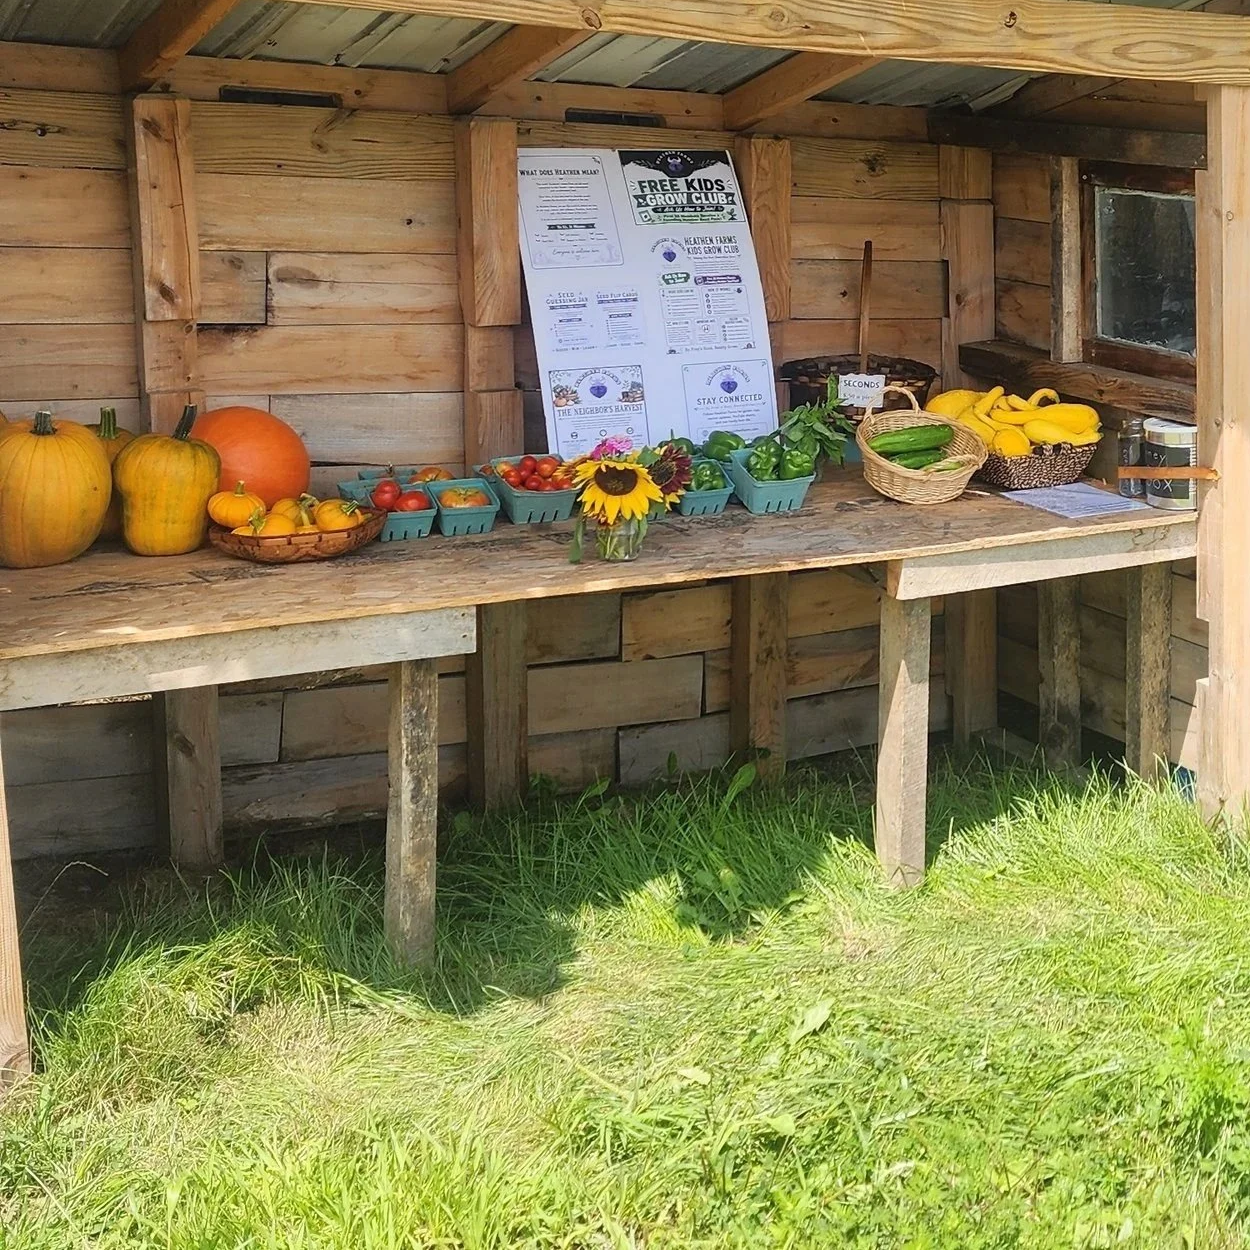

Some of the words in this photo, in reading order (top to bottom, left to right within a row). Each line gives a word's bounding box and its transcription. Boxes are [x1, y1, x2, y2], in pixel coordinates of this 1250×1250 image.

[637, 179, 680, 193] FREE
[684, 178, 725, 192] KIDS
[646, 193, 688, 206] GROW
[691, 192, 728, 204] CLUB
[684, 236, 714, 246] HEATHEN
[715, 236, 737, 244] FARMS
[687, 246, 702, 255] KIDS
[704, 246, 722, 254] GROW
[724, 245, 740, 253] CLUB
[844, 380, 880, 388] SECONDS
[697, 397, 716, 406] STAY
[719, 394, 762, 404] CONNECTED
[574, 406, 613, 415] NEIGHBOR'S
[615, 404, 643, 413] HARVEST
